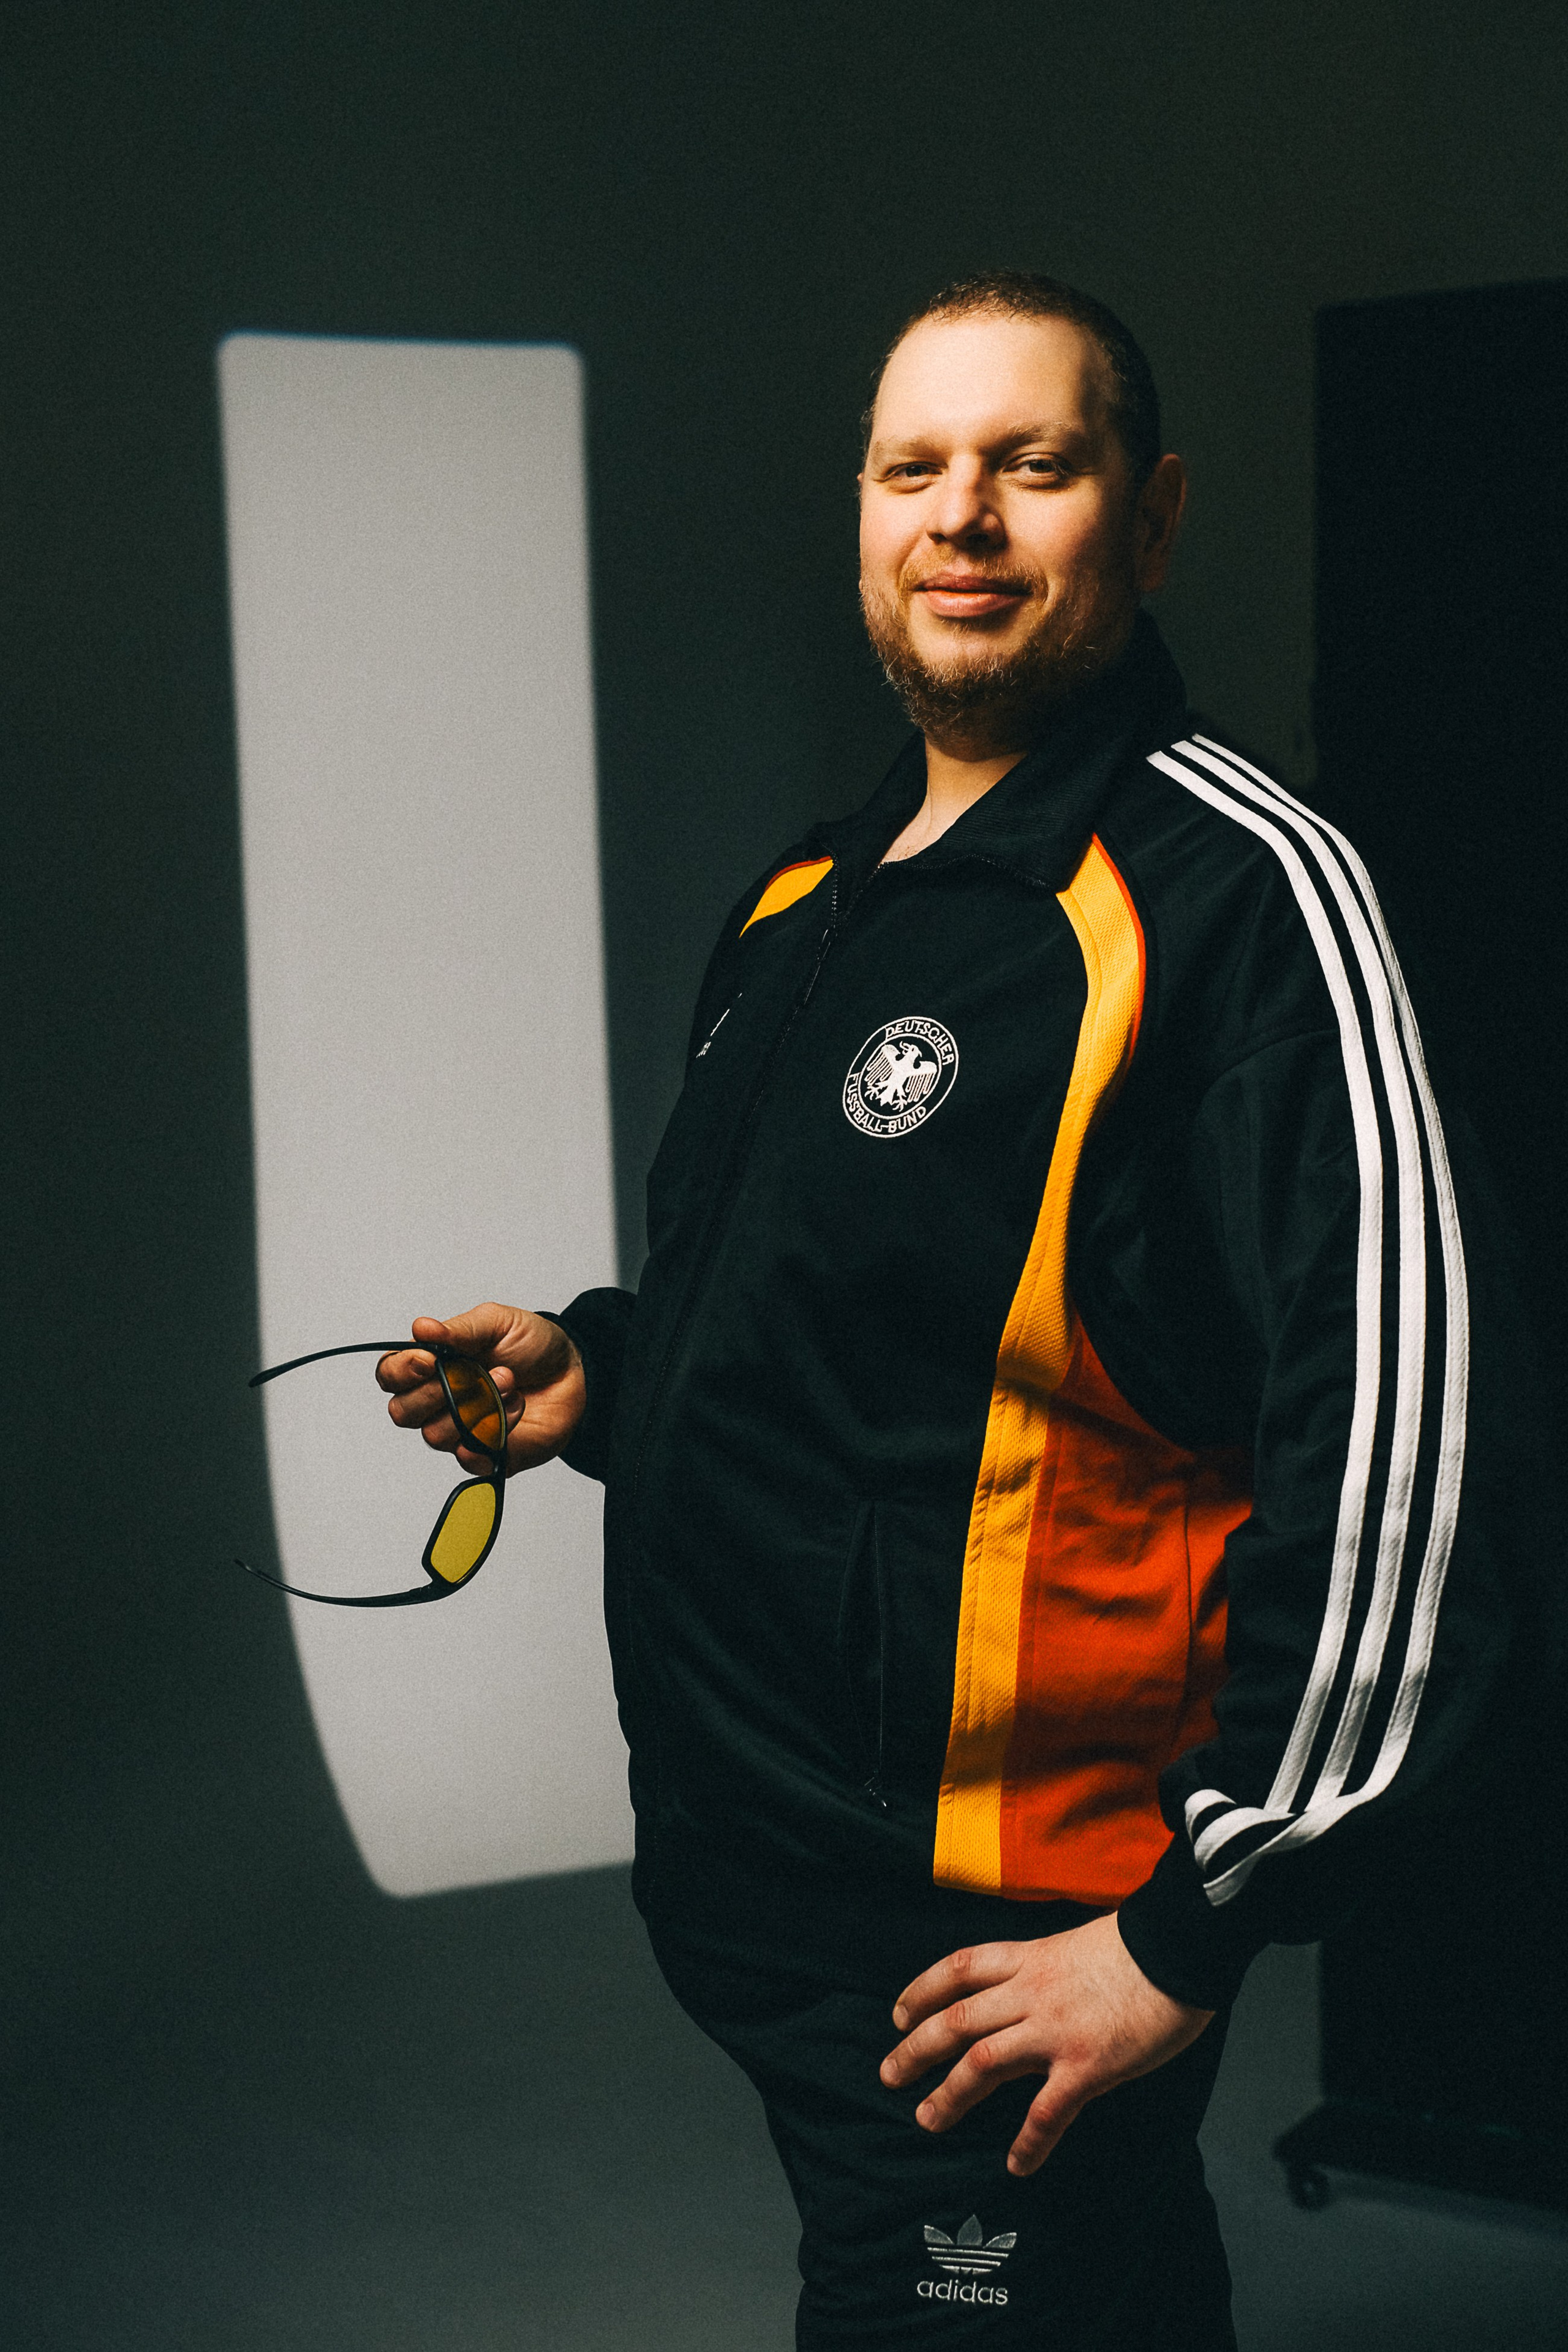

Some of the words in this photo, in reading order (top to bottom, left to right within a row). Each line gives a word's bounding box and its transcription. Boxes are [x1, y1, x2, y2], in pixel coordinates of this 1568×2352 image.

[885, 1019, 955, 1066] DEUTSCHER
[846, 1072, 927, 1133] FUSSBALL-BUND
[916, 2278, 1008, 2305] adidas
